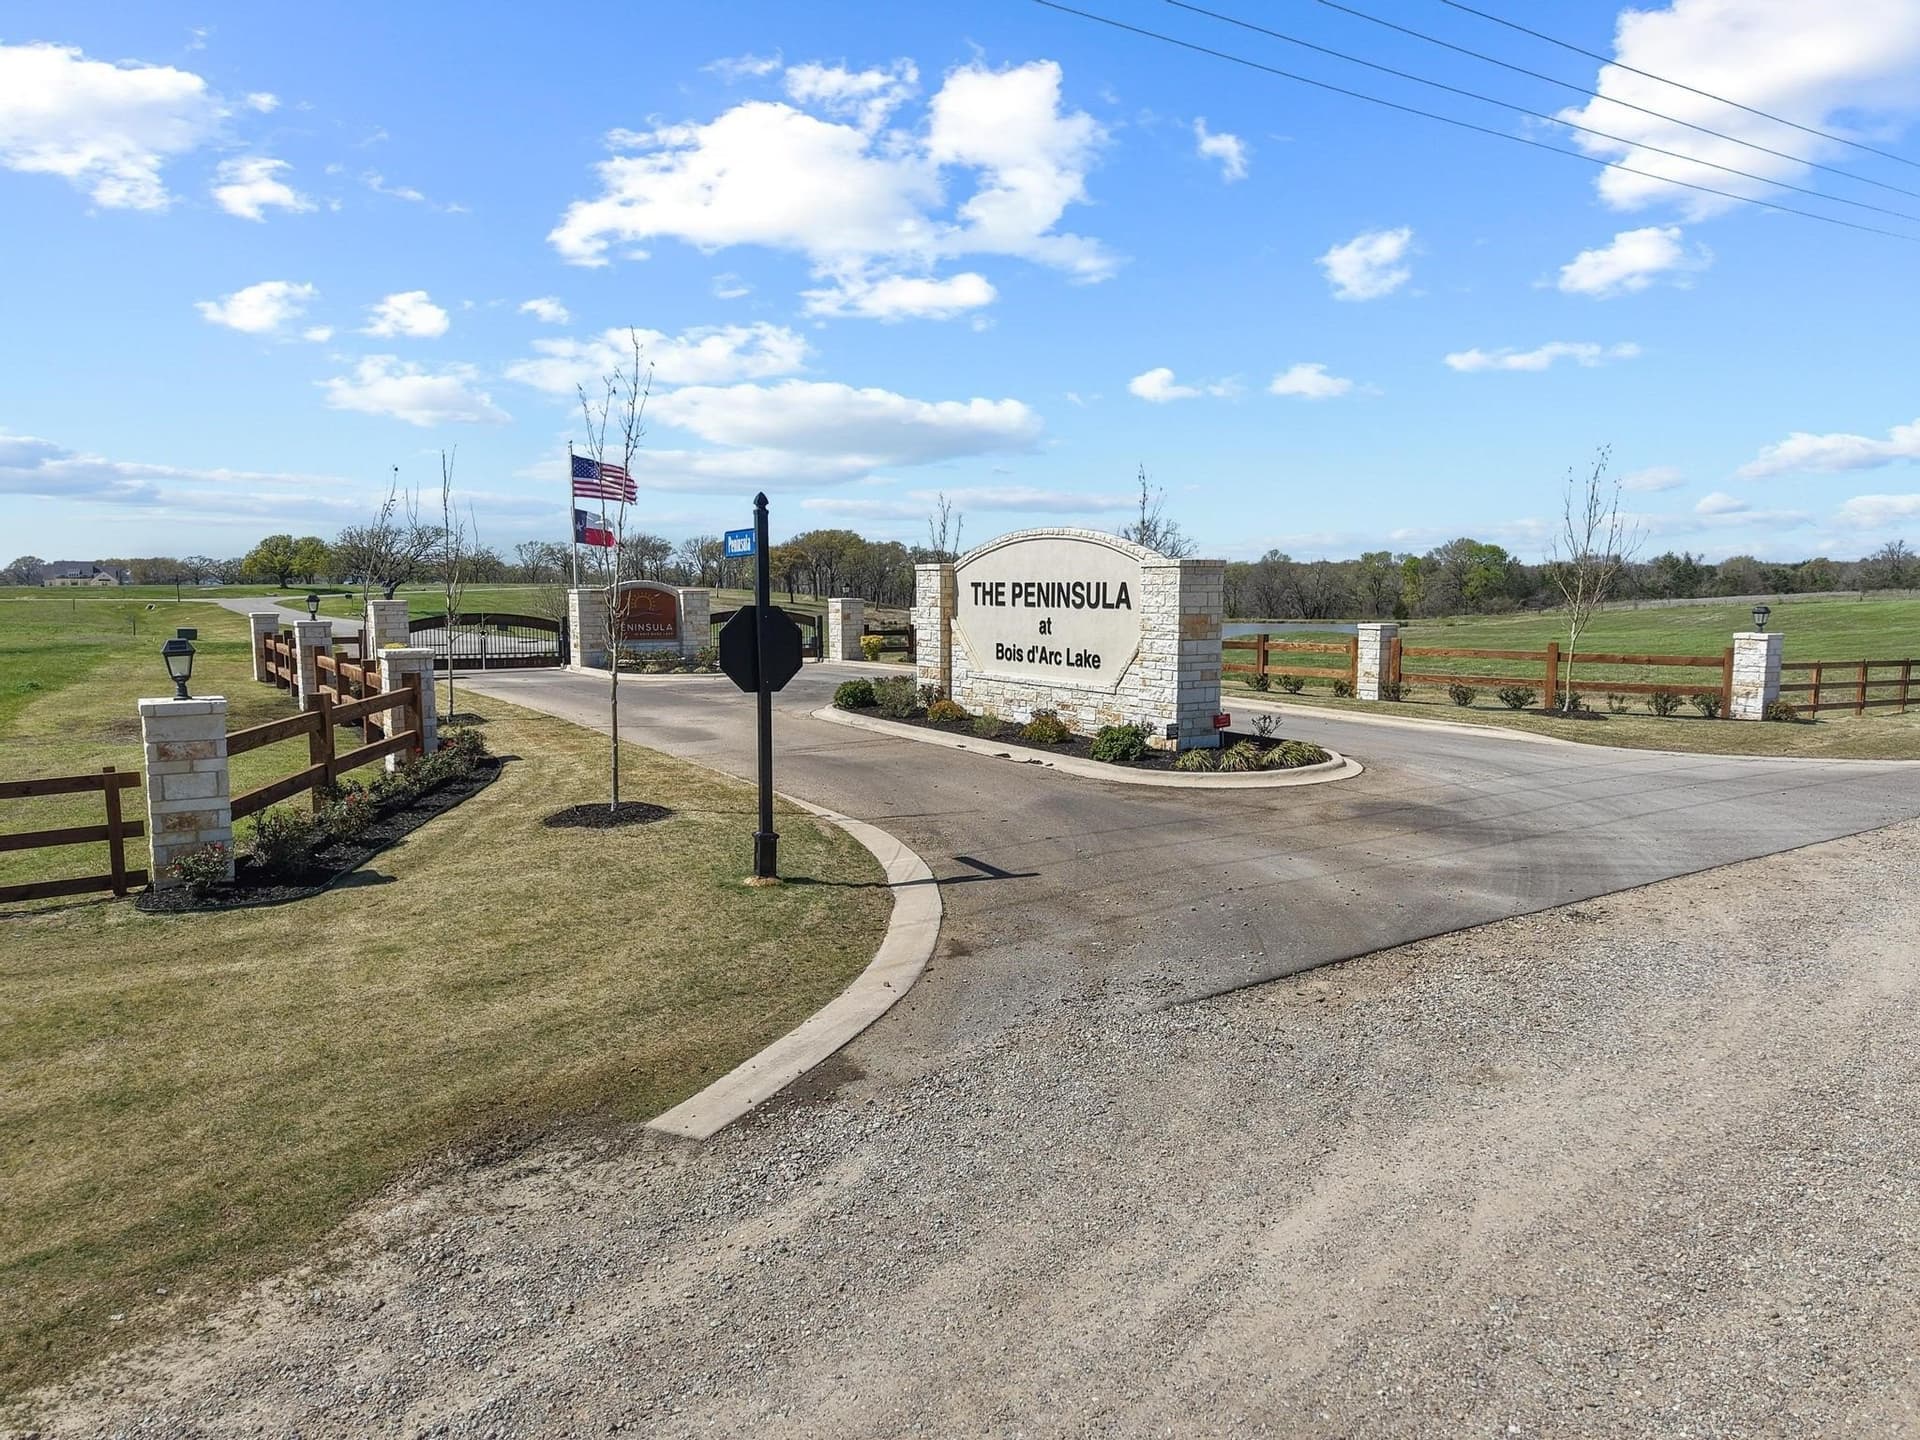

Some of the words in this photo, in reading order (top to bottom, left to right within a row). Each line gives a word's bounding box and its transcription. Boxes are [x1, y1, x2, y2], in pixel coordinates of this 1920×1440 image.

[970, 581, 1006, 607] THE
[1011, 581, 1132, 610] PENINSULA
[616, 623, 673, 632] ENINSULA
[1038, 617, 1052, 635] at
[995, 643, 1023, 661] Bois
[1027, 644, 1062, 666] d'Arc
[1066, 649, 1101, 670] Lake
